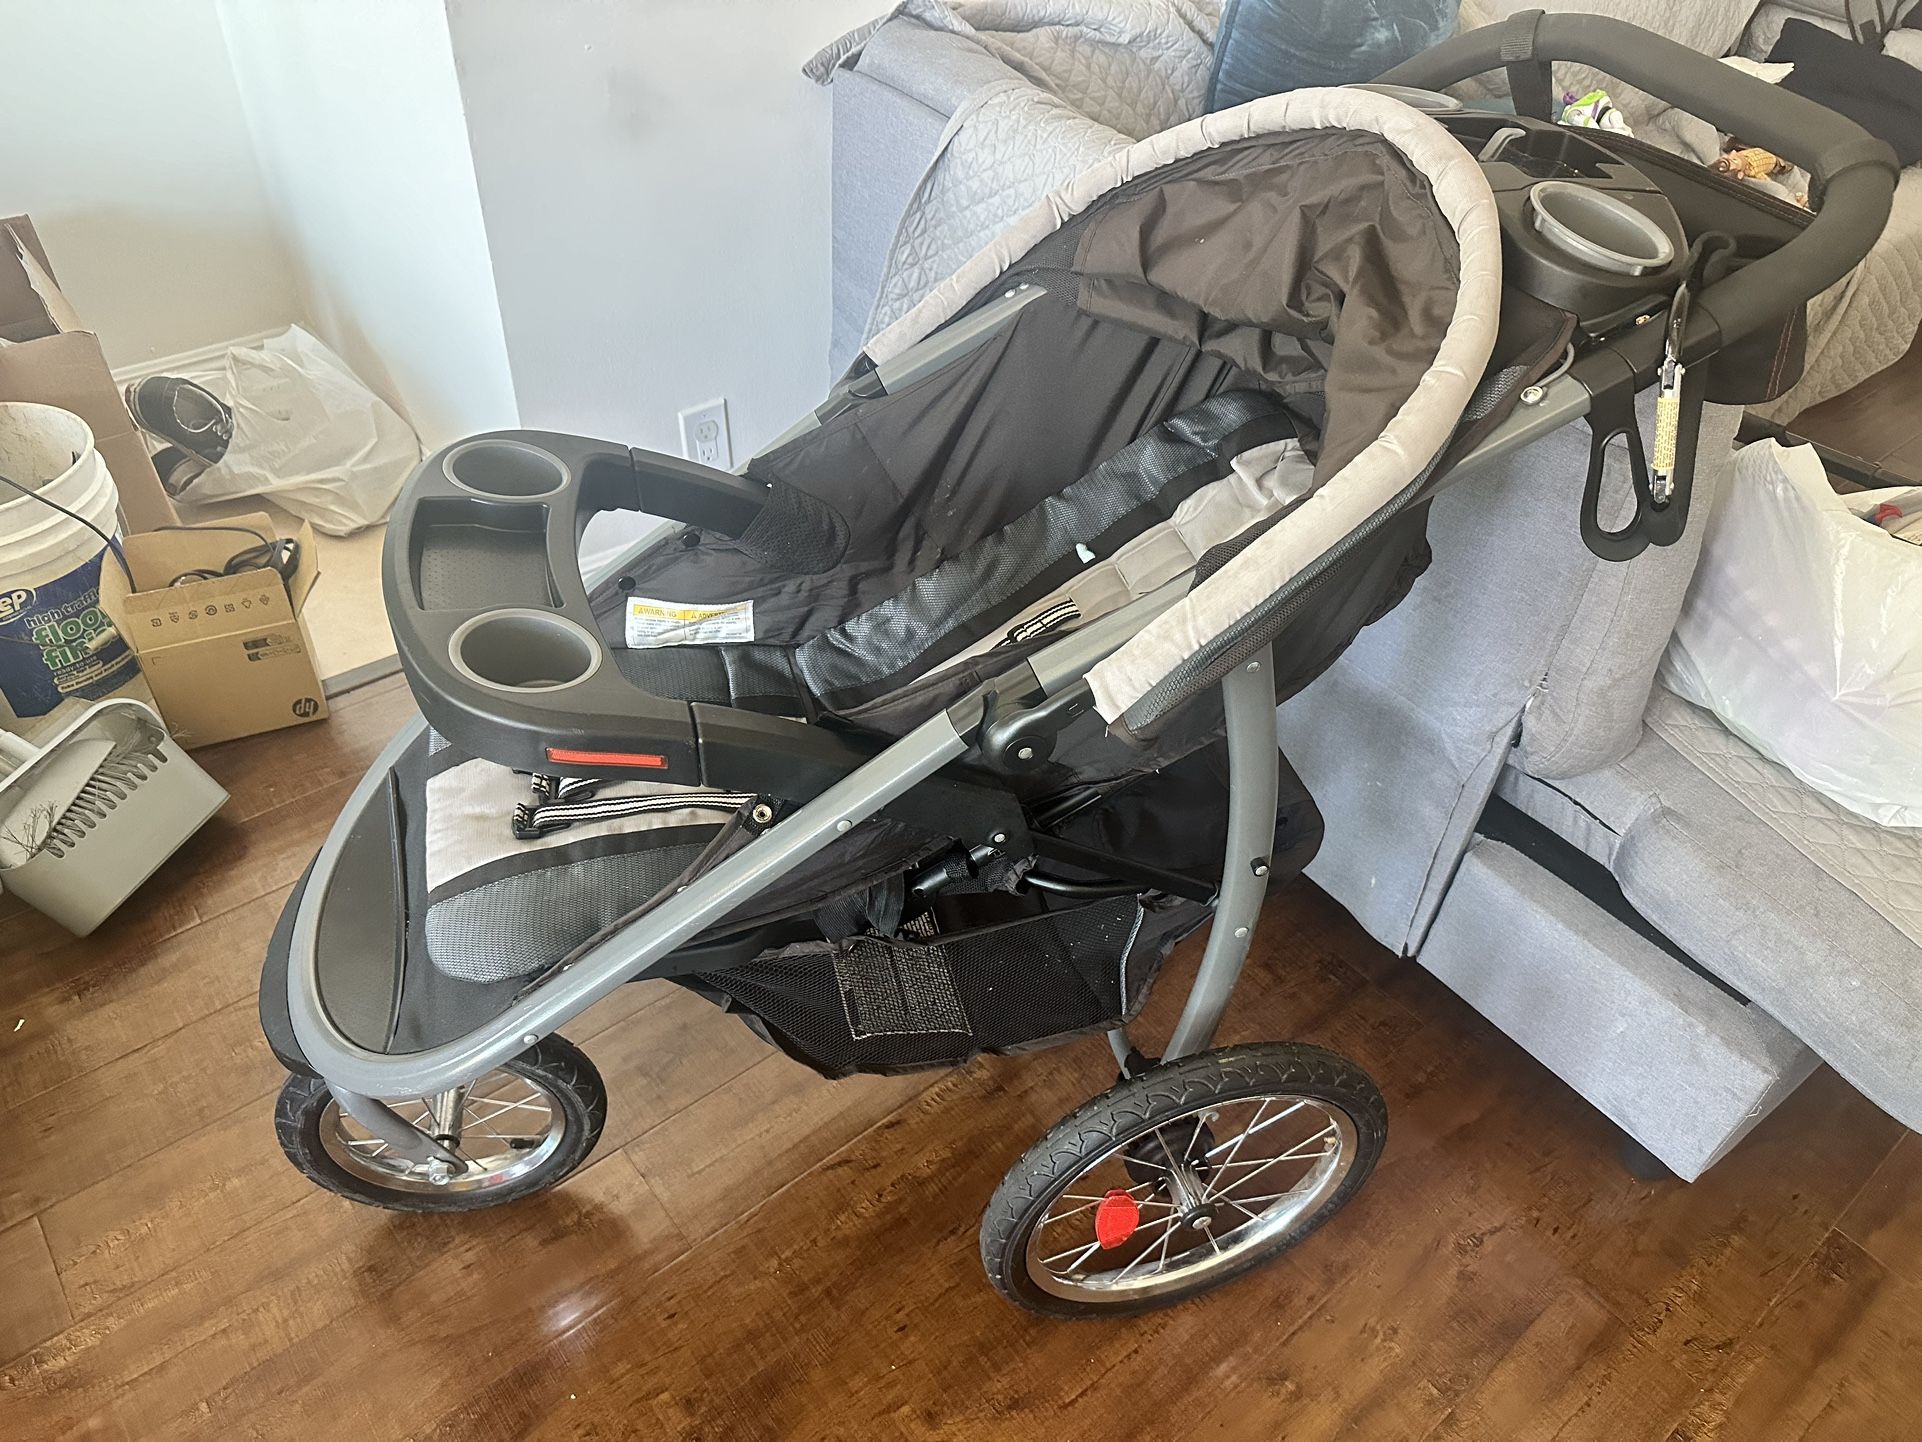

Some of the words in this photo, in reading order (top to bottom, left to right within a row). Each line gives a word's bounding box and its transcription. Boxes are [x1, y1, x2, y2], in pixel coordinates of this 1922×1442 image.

[0, 590, 27, 618] eP
[61, 587, 99, 615] traffi
[643, 607, 677, 618] WARNNG
[293, 697, 319, 718] hp
